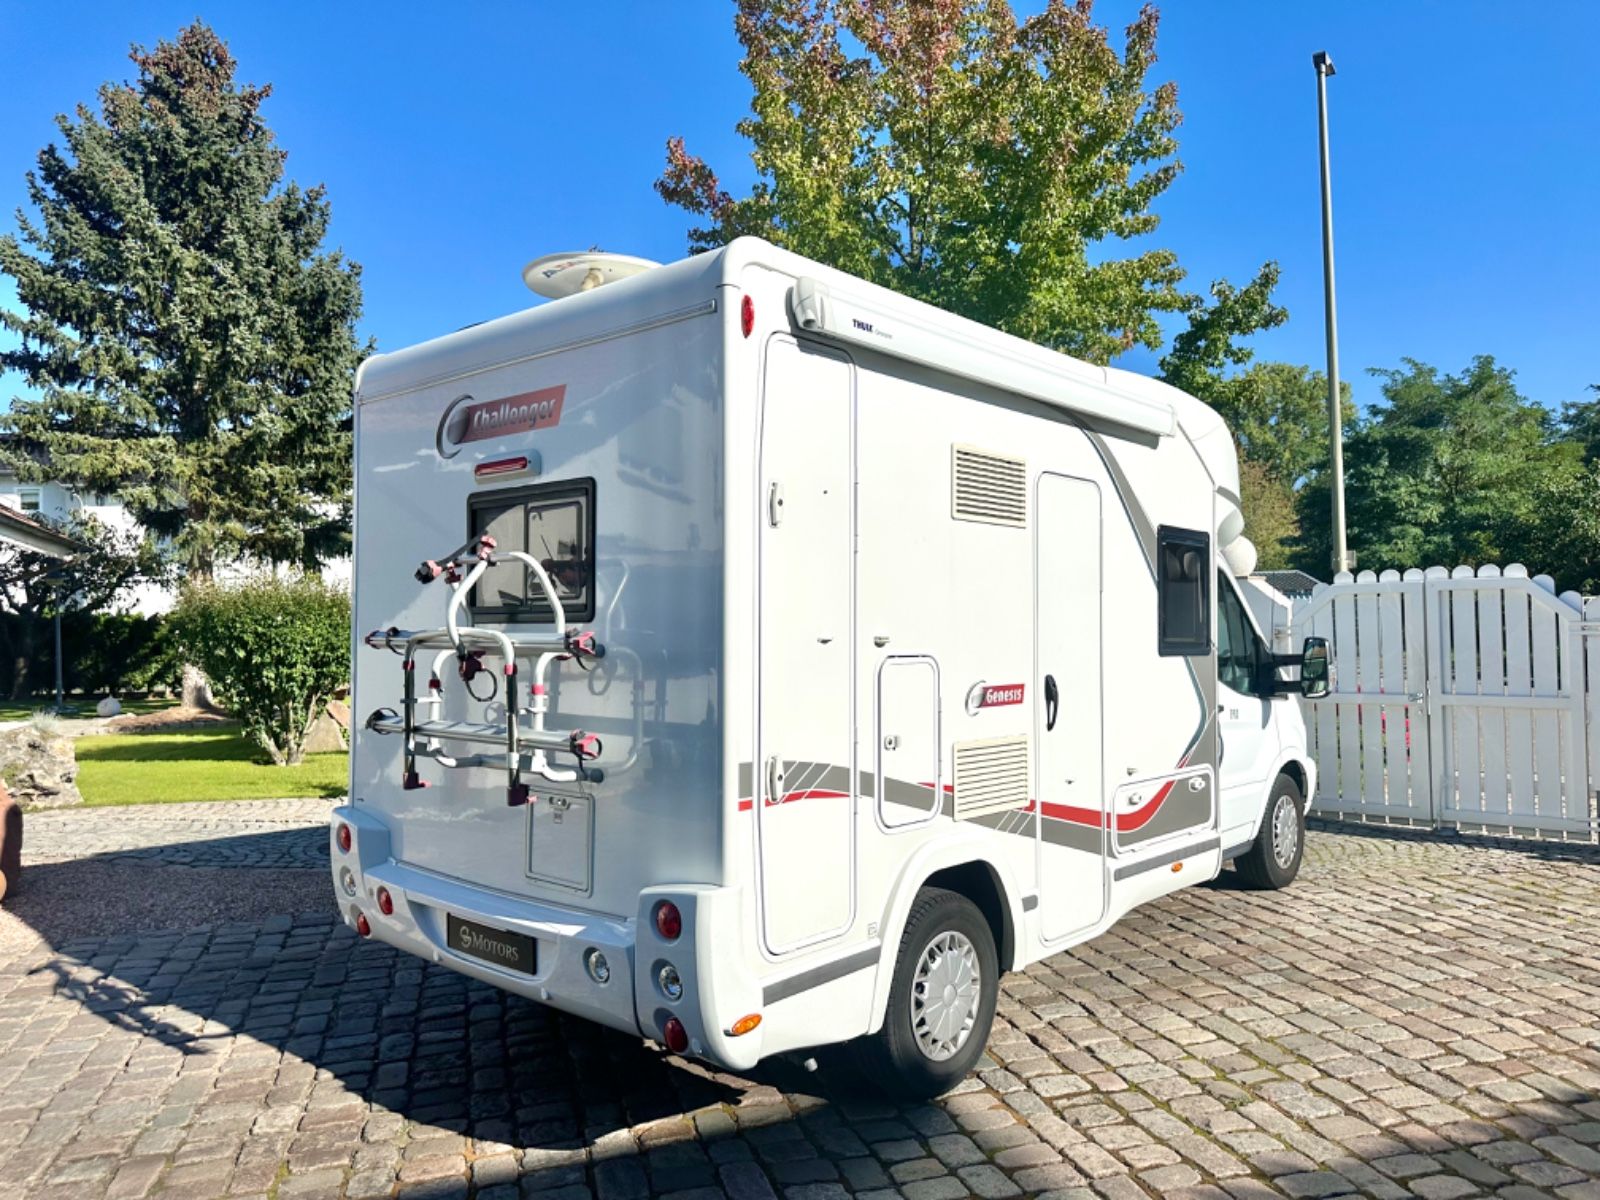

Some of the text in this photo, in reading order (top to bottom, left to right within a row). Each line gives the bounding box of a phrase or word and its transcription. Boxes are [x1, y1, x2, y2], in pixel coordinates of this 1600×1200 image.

[473, 399, 556, 428] Challenger
[986, 688, 1022, 704] Genesis
[471, 931, 519, 961] MOTORS
